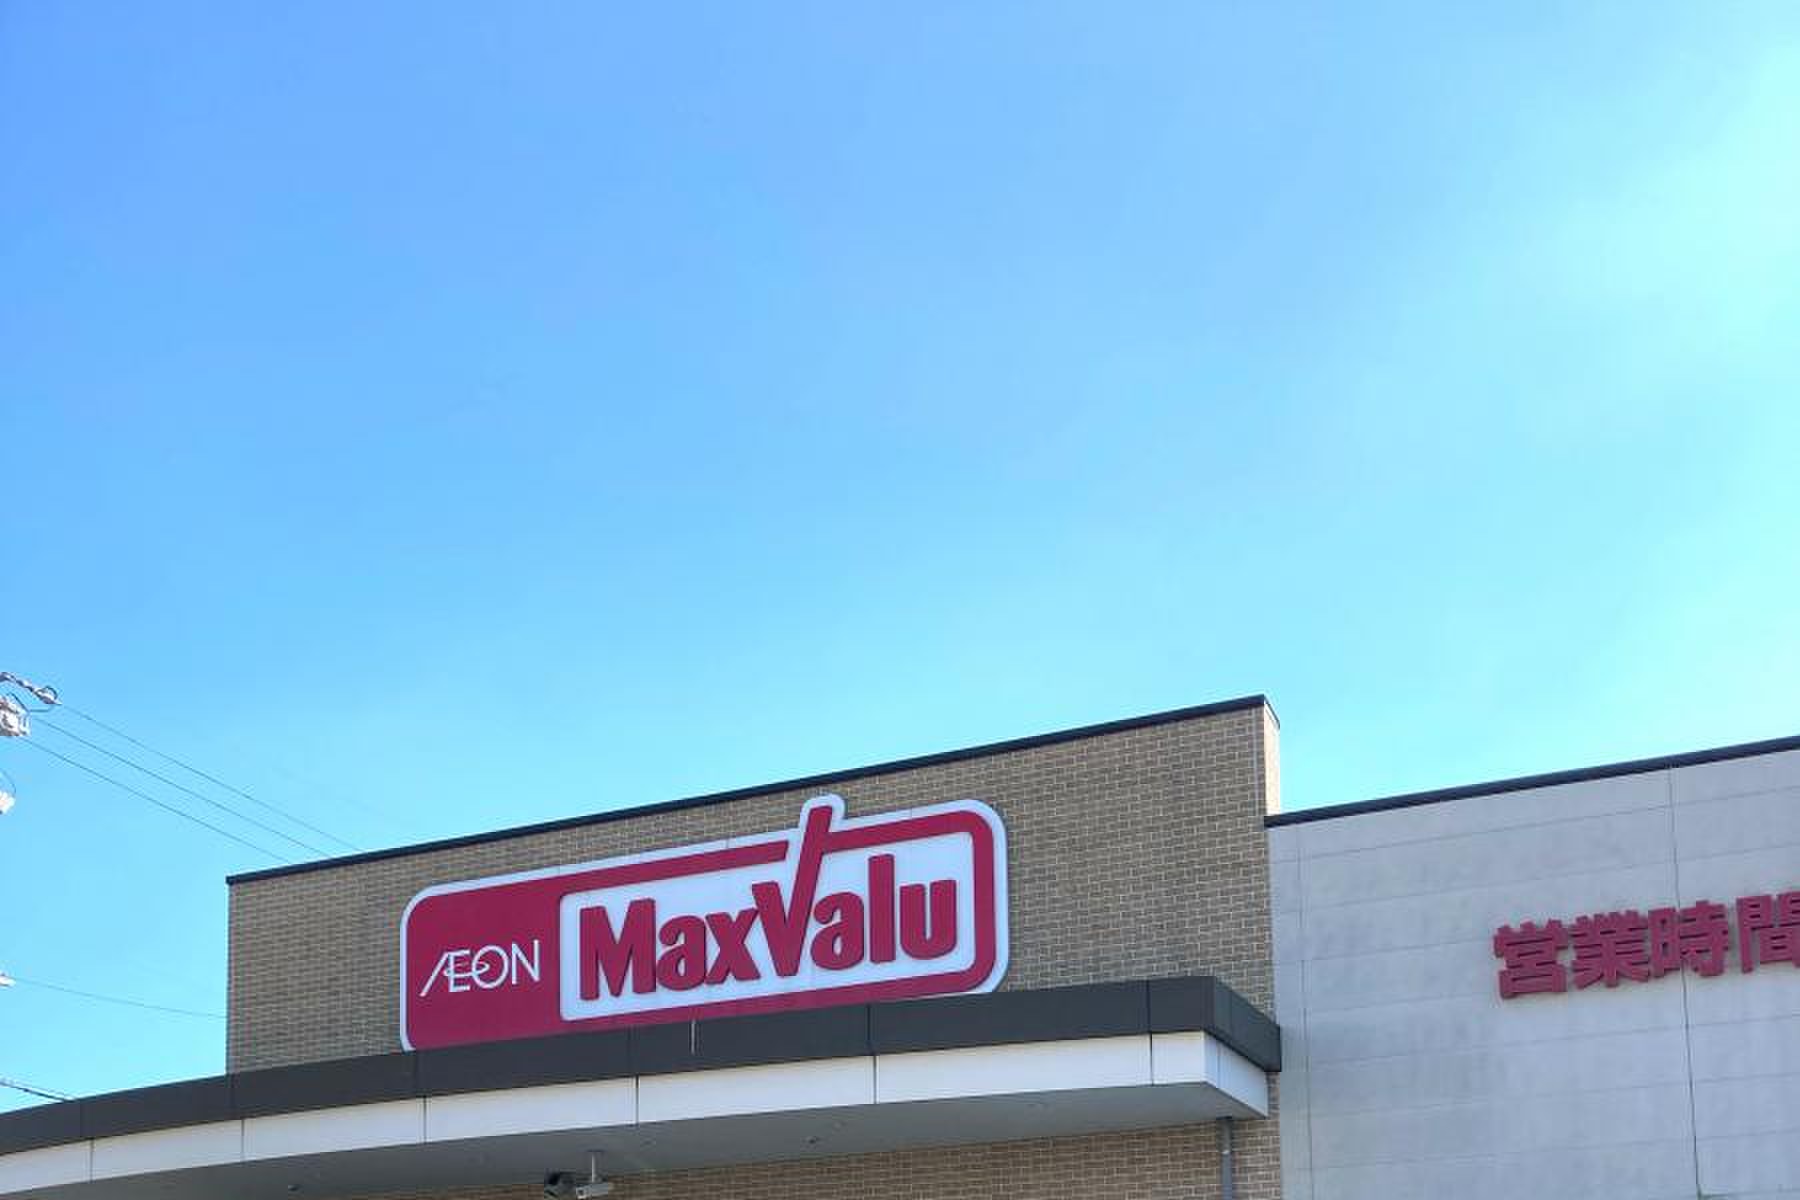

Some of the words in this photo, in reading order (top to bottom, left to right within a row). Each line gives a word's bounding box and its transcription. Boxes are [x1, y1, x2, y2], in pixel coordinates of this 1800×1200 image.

[579, 805, 959, 1001] MaxValu
[1493, 891, 1800, 1000] 営業時間
